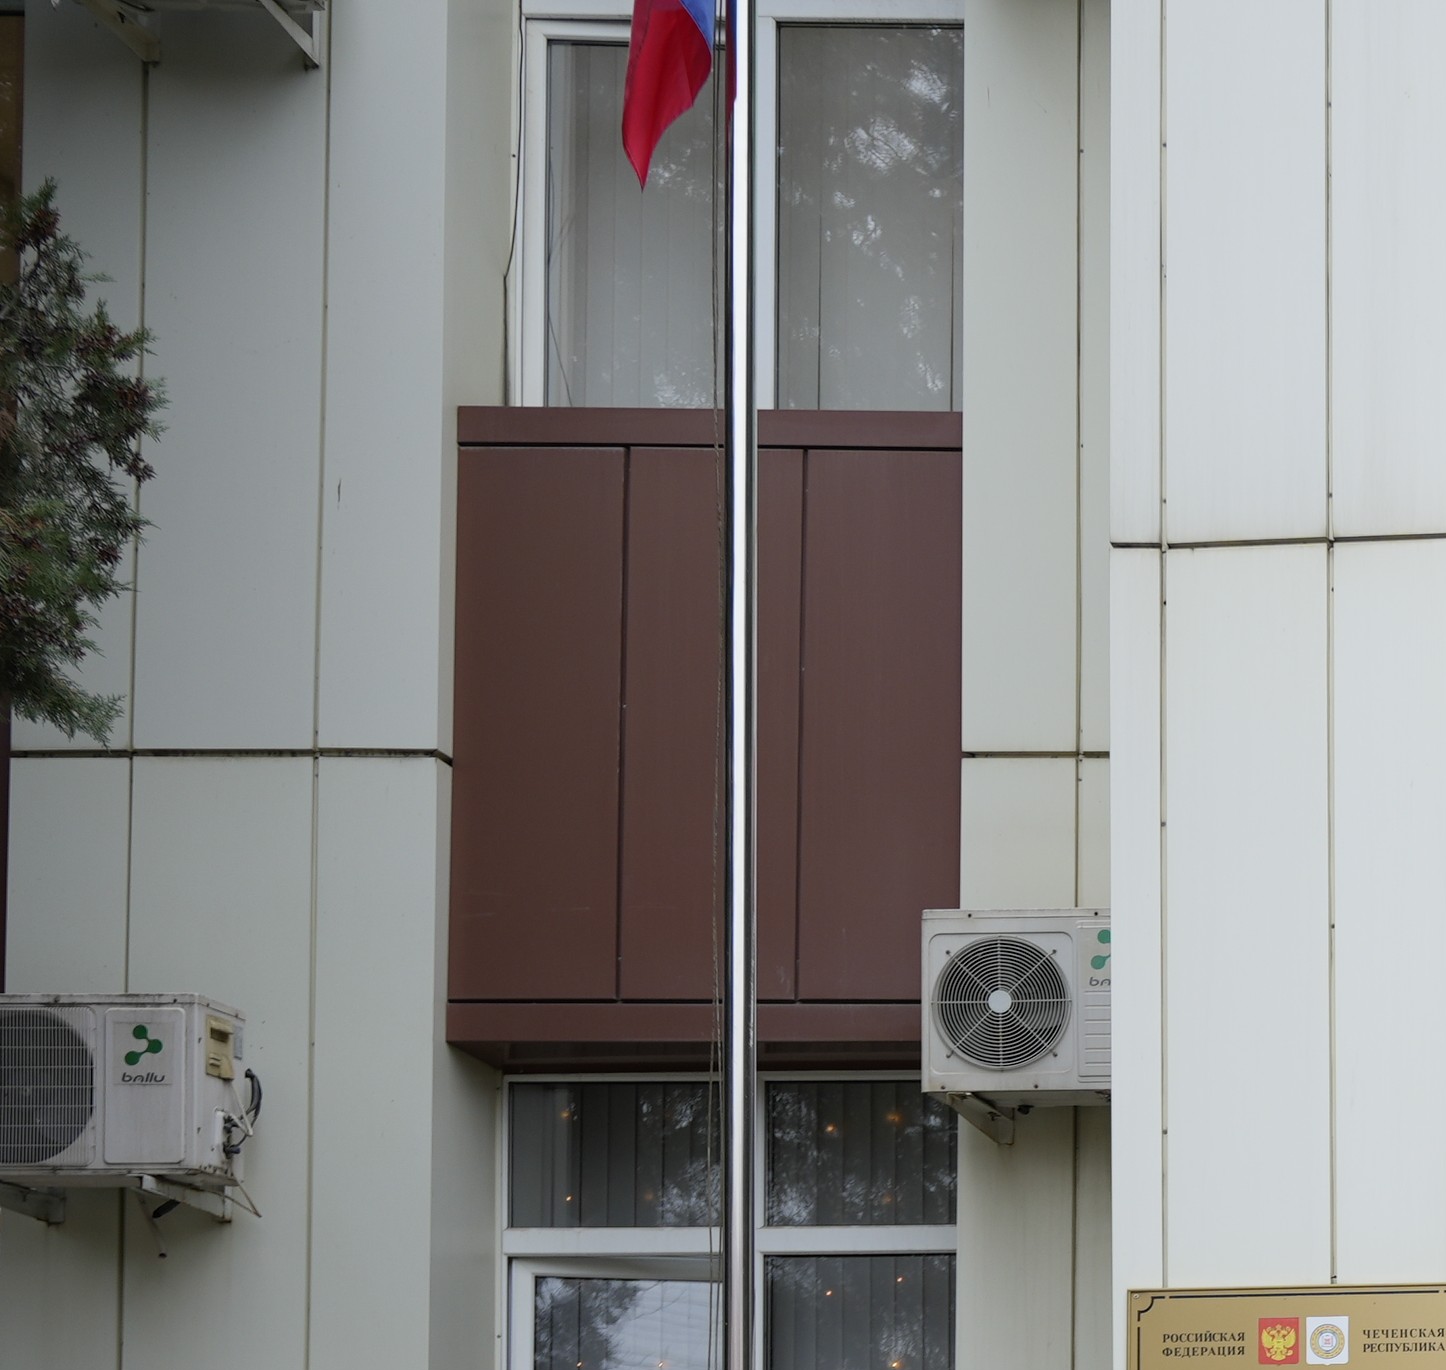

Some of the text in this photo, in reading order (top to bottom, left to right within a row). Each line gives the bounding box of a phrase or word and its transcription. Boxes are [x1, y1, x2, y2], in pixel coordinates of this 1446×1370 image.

[1162, 1330, 1245, 1343] РОССИЙСКАЯ
[1362, 1328, 1445, 1339] ЧЕЧЕНСКАЯ
[1162, 1345, 1245, 1358] ФЕДЕРАЦИЯ
[1363, 1342, 1445, 1353] РЕСПУБЛИКА
